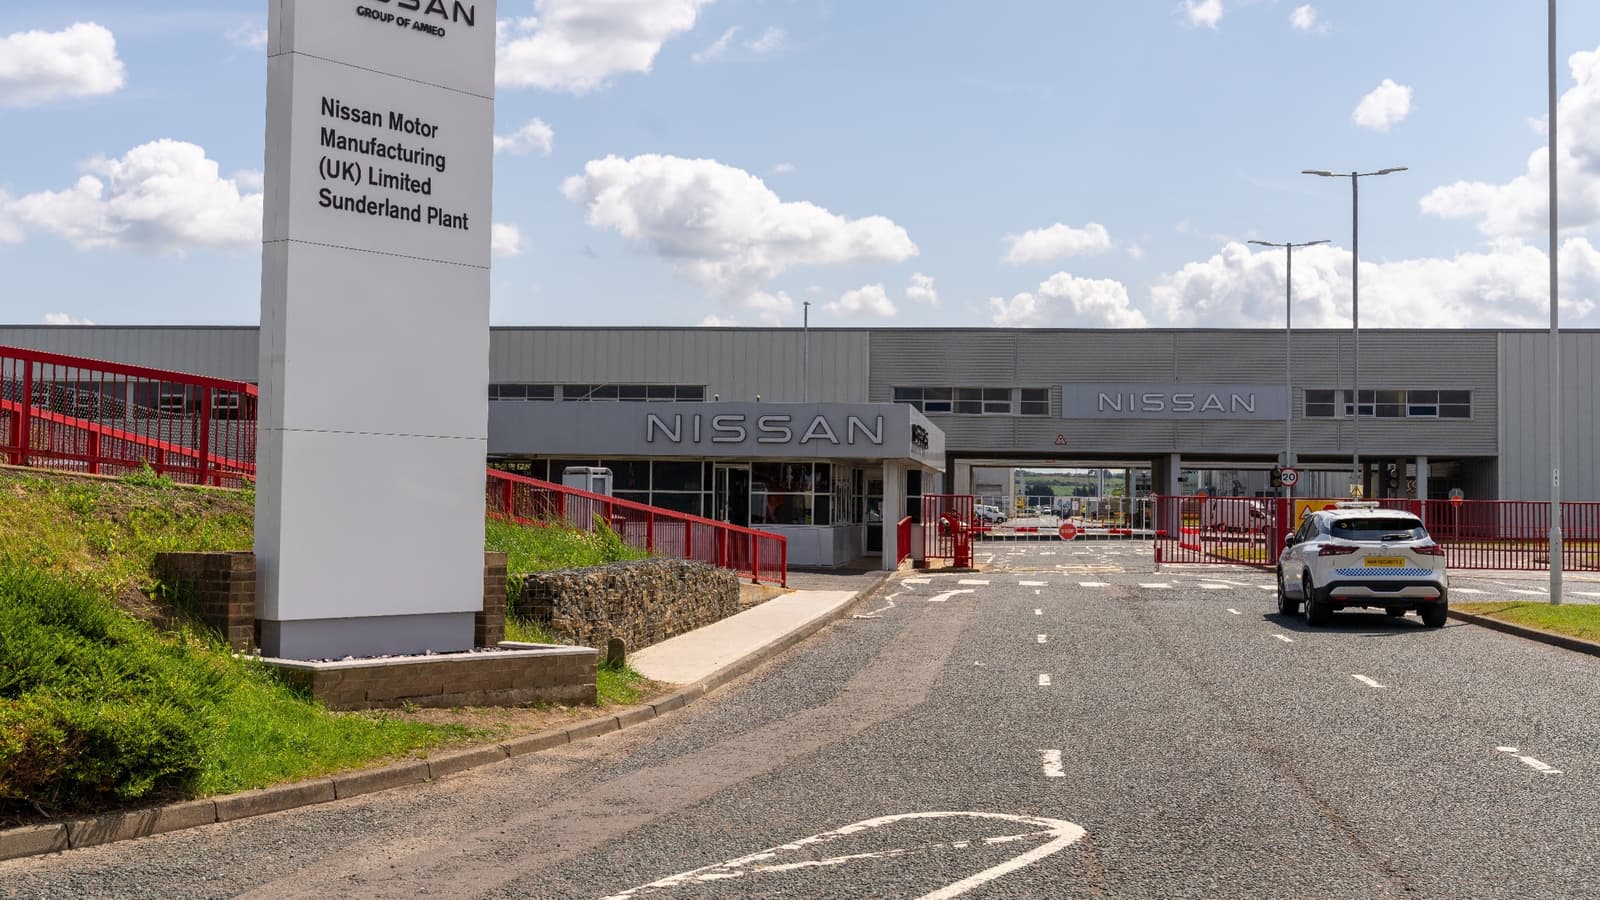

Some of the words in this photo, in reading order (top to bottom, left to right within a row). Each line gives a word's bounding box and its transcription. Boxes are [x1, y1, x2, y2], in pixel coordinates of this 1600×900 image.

[356, 5, 395, 23] GROUP
[396, 16, 411, 28] OF
[412, 21, 446, 38] AMIEO
[321, 96, 382, 127] Nissan
[388, 111, 438, 139] Motor
[320, 126, 446, 173] Manufacturing
[319, 156, 361, 186] (UK)
[368, 166, 432, 195] Limited
[318, 188, 421, 223] Sunderland
[427, 206, 469, 230] Plant
[1097, 392, 1256, 414] NISSAN
[646, 413, 884, 445] NISSAN
[1282, 473, 1296, 481] 20
